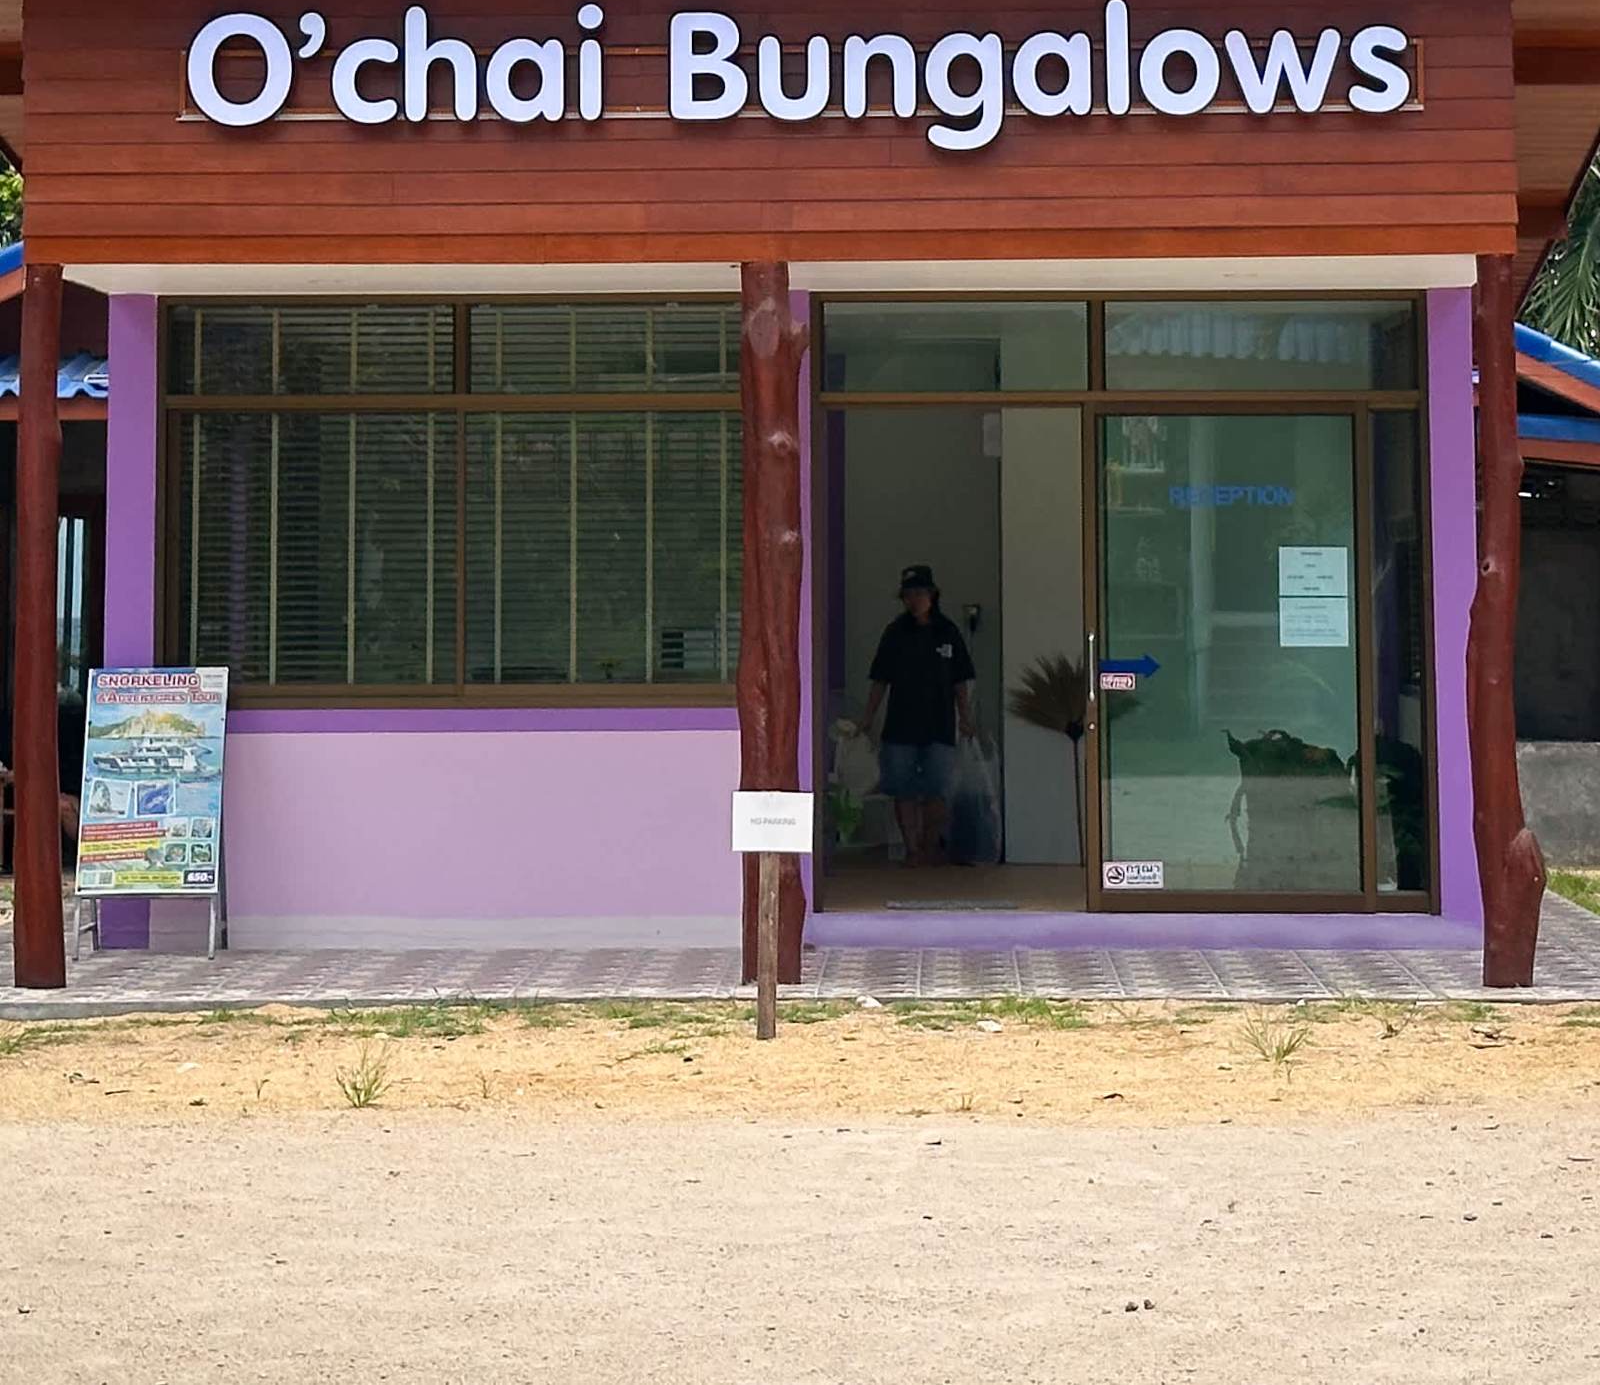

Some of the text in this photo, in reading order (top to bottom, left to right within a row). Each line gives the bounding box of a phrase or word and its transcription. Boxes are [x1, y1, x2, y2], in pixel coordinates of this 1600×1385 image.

[186, 3, 604, 127] O'chai
[1168, 485, 1297, 506] RECEPTION
[98, 673, 200, 687] SNORKELING
